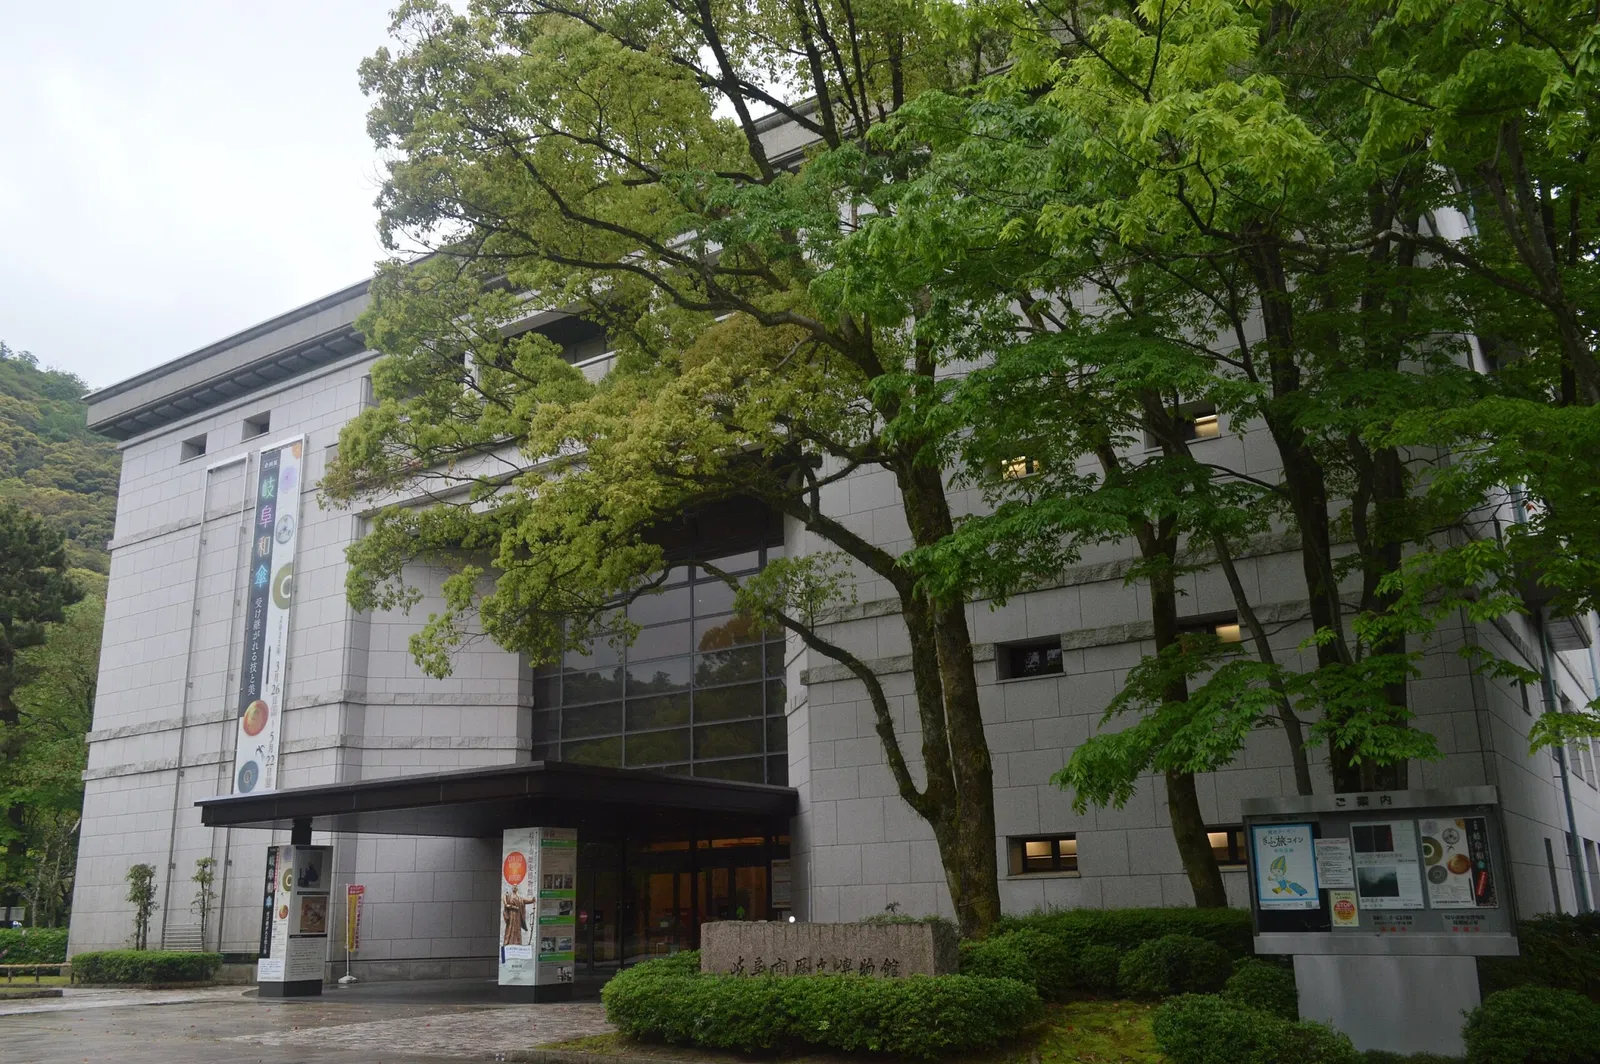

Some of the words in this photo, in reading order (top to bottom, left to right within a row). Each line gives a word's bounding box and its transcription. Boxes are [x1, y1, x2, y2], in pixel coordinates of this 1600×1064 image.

[254, 476, 276, 588] 岐阜和傘
[1336, 795, 1393, 807] ご案内
[1262, 836, 1304, 848] ぎふ旅コイン
